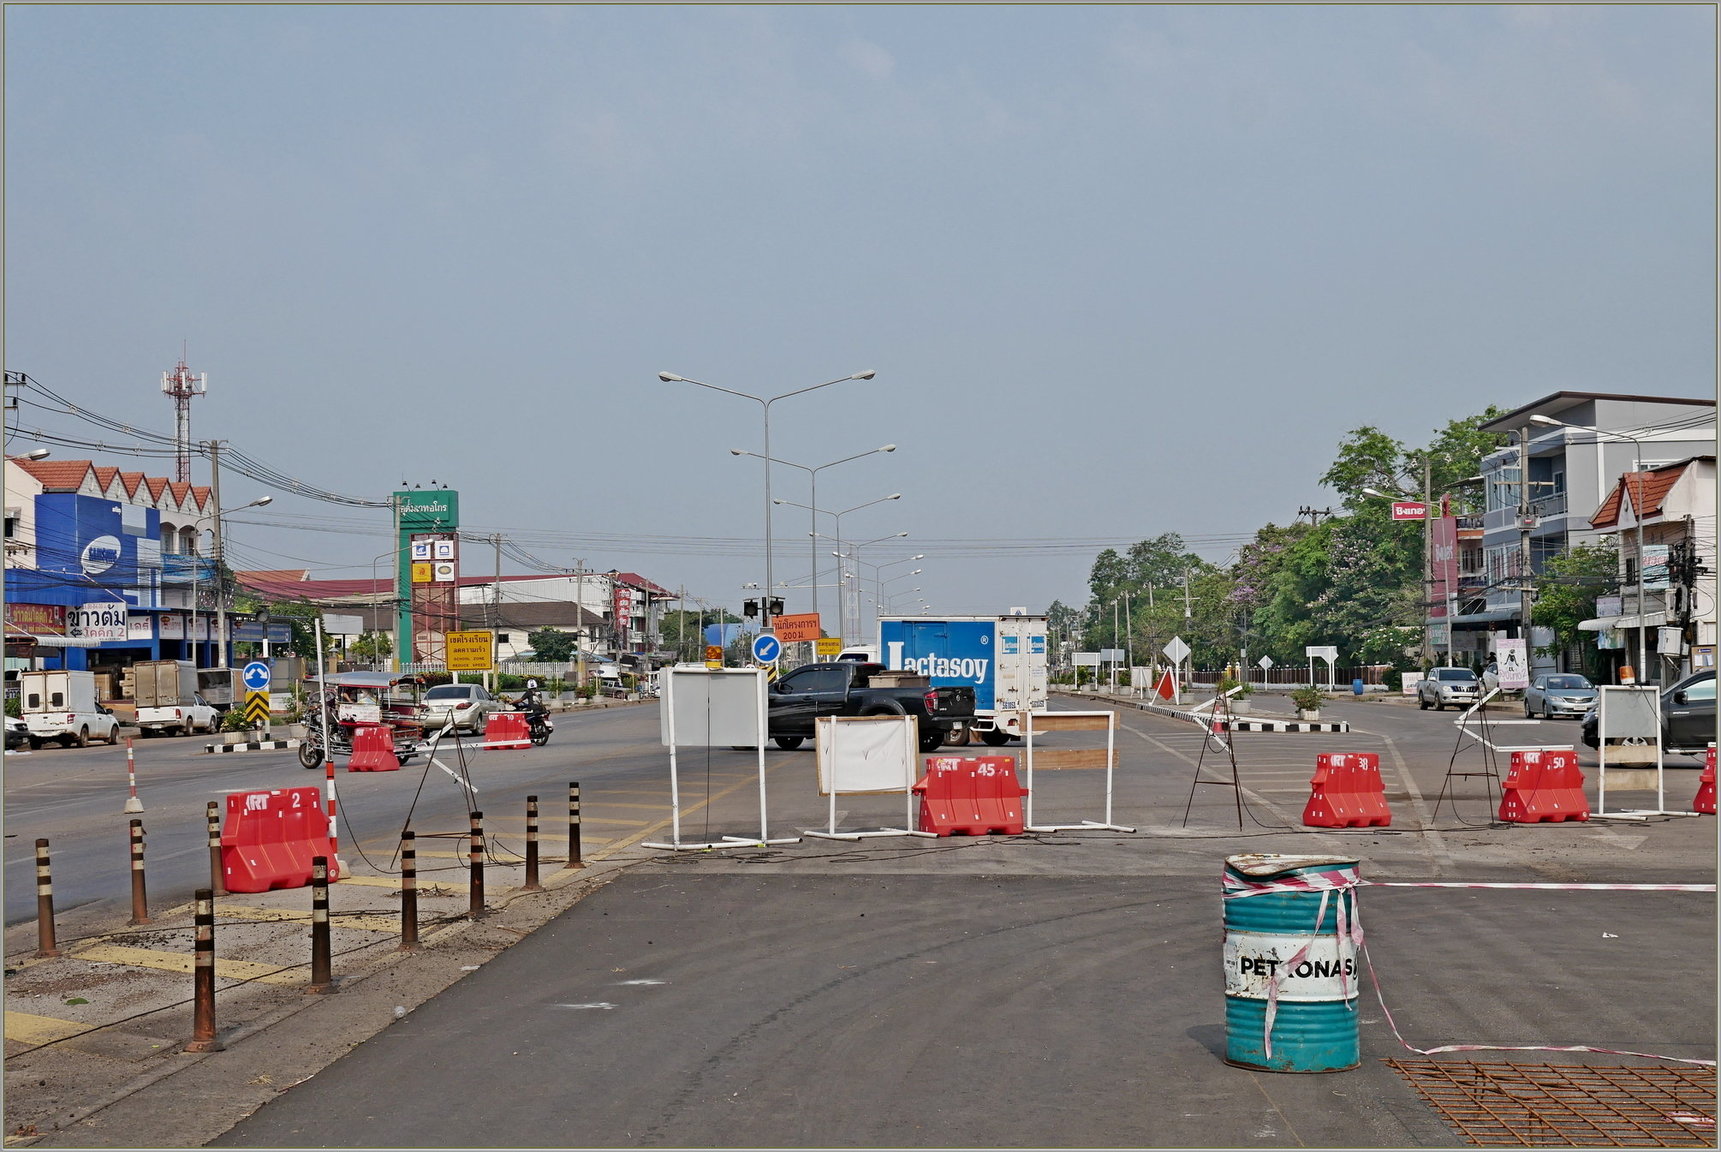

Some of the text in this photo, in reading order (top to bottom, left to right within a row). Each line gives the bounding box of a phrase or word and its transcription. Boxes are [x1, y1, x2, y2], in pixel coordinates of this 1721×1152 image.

[67, 603, 126, 627] ข้าวต้ม
[117, 627, 125, 637] 2
[888, 641, 988, 684] Lactasoy
[1553, 756, 1565, 769] 50
[978, 764, 996, 777] 45
[292, 793, 301, 808] 2
[1241, 956, 1352, 978] PETONAS
